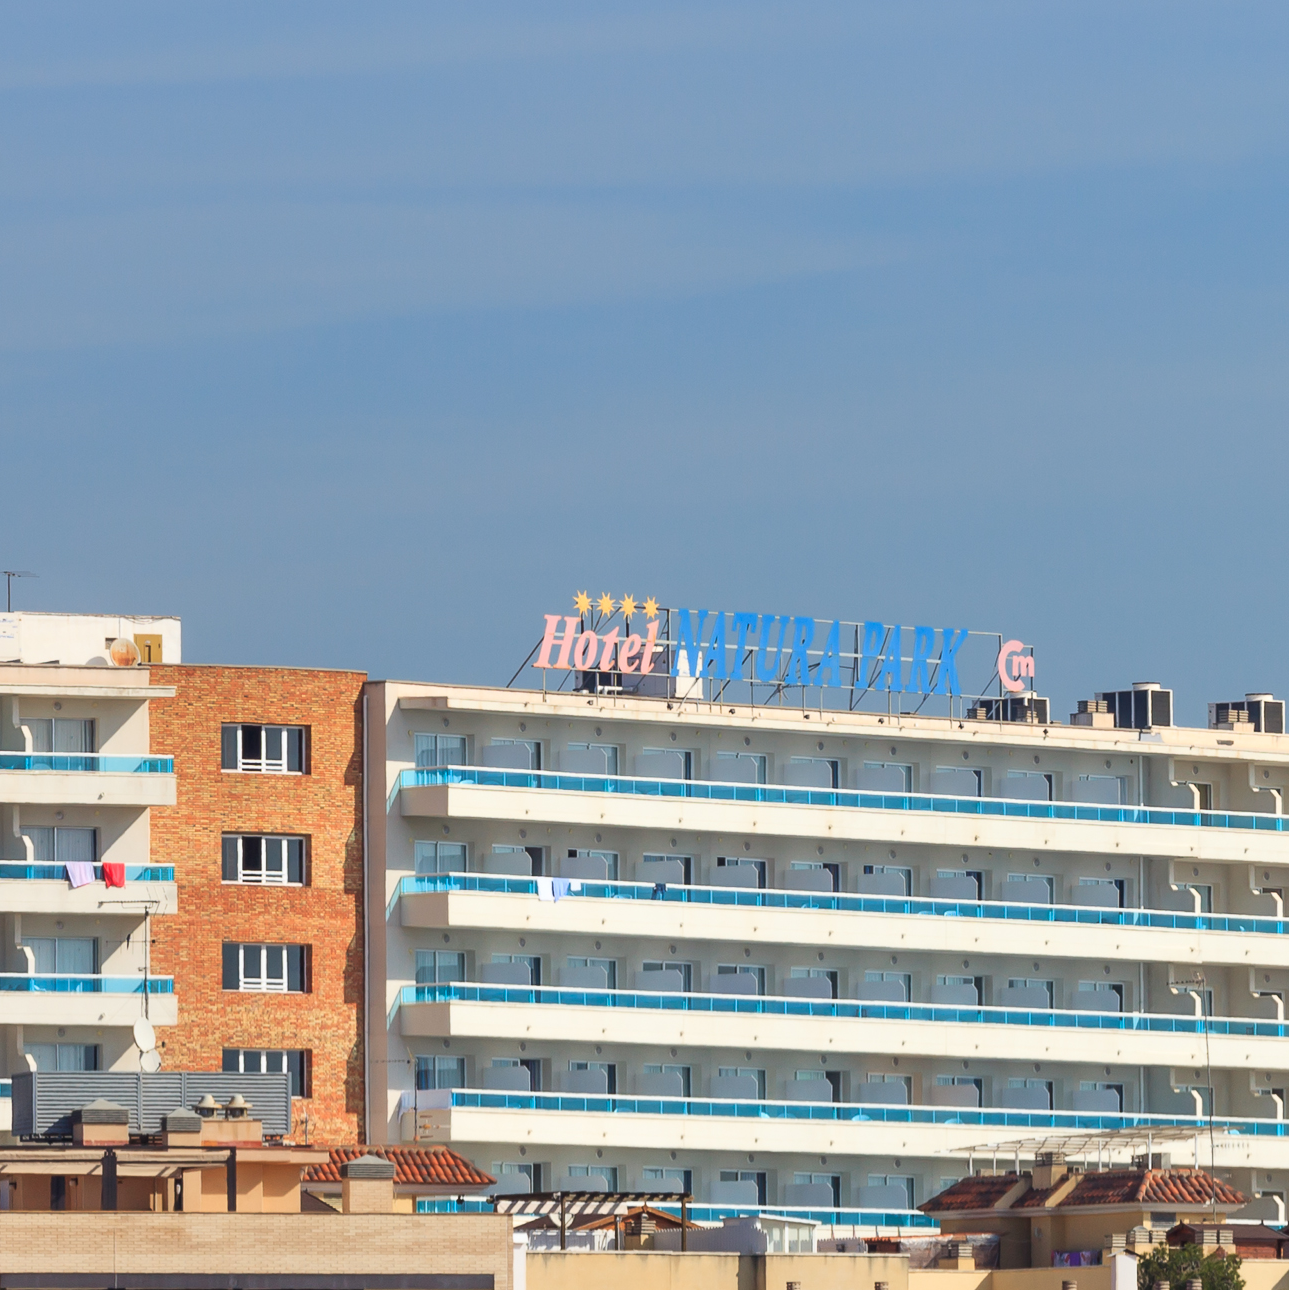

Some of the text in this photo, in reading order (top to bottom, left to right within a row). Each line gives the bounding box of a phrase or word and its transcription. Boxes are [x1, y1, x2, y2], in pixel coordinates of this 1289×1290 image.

[532, 608, 969, 696] Hotel NATURA PARK
